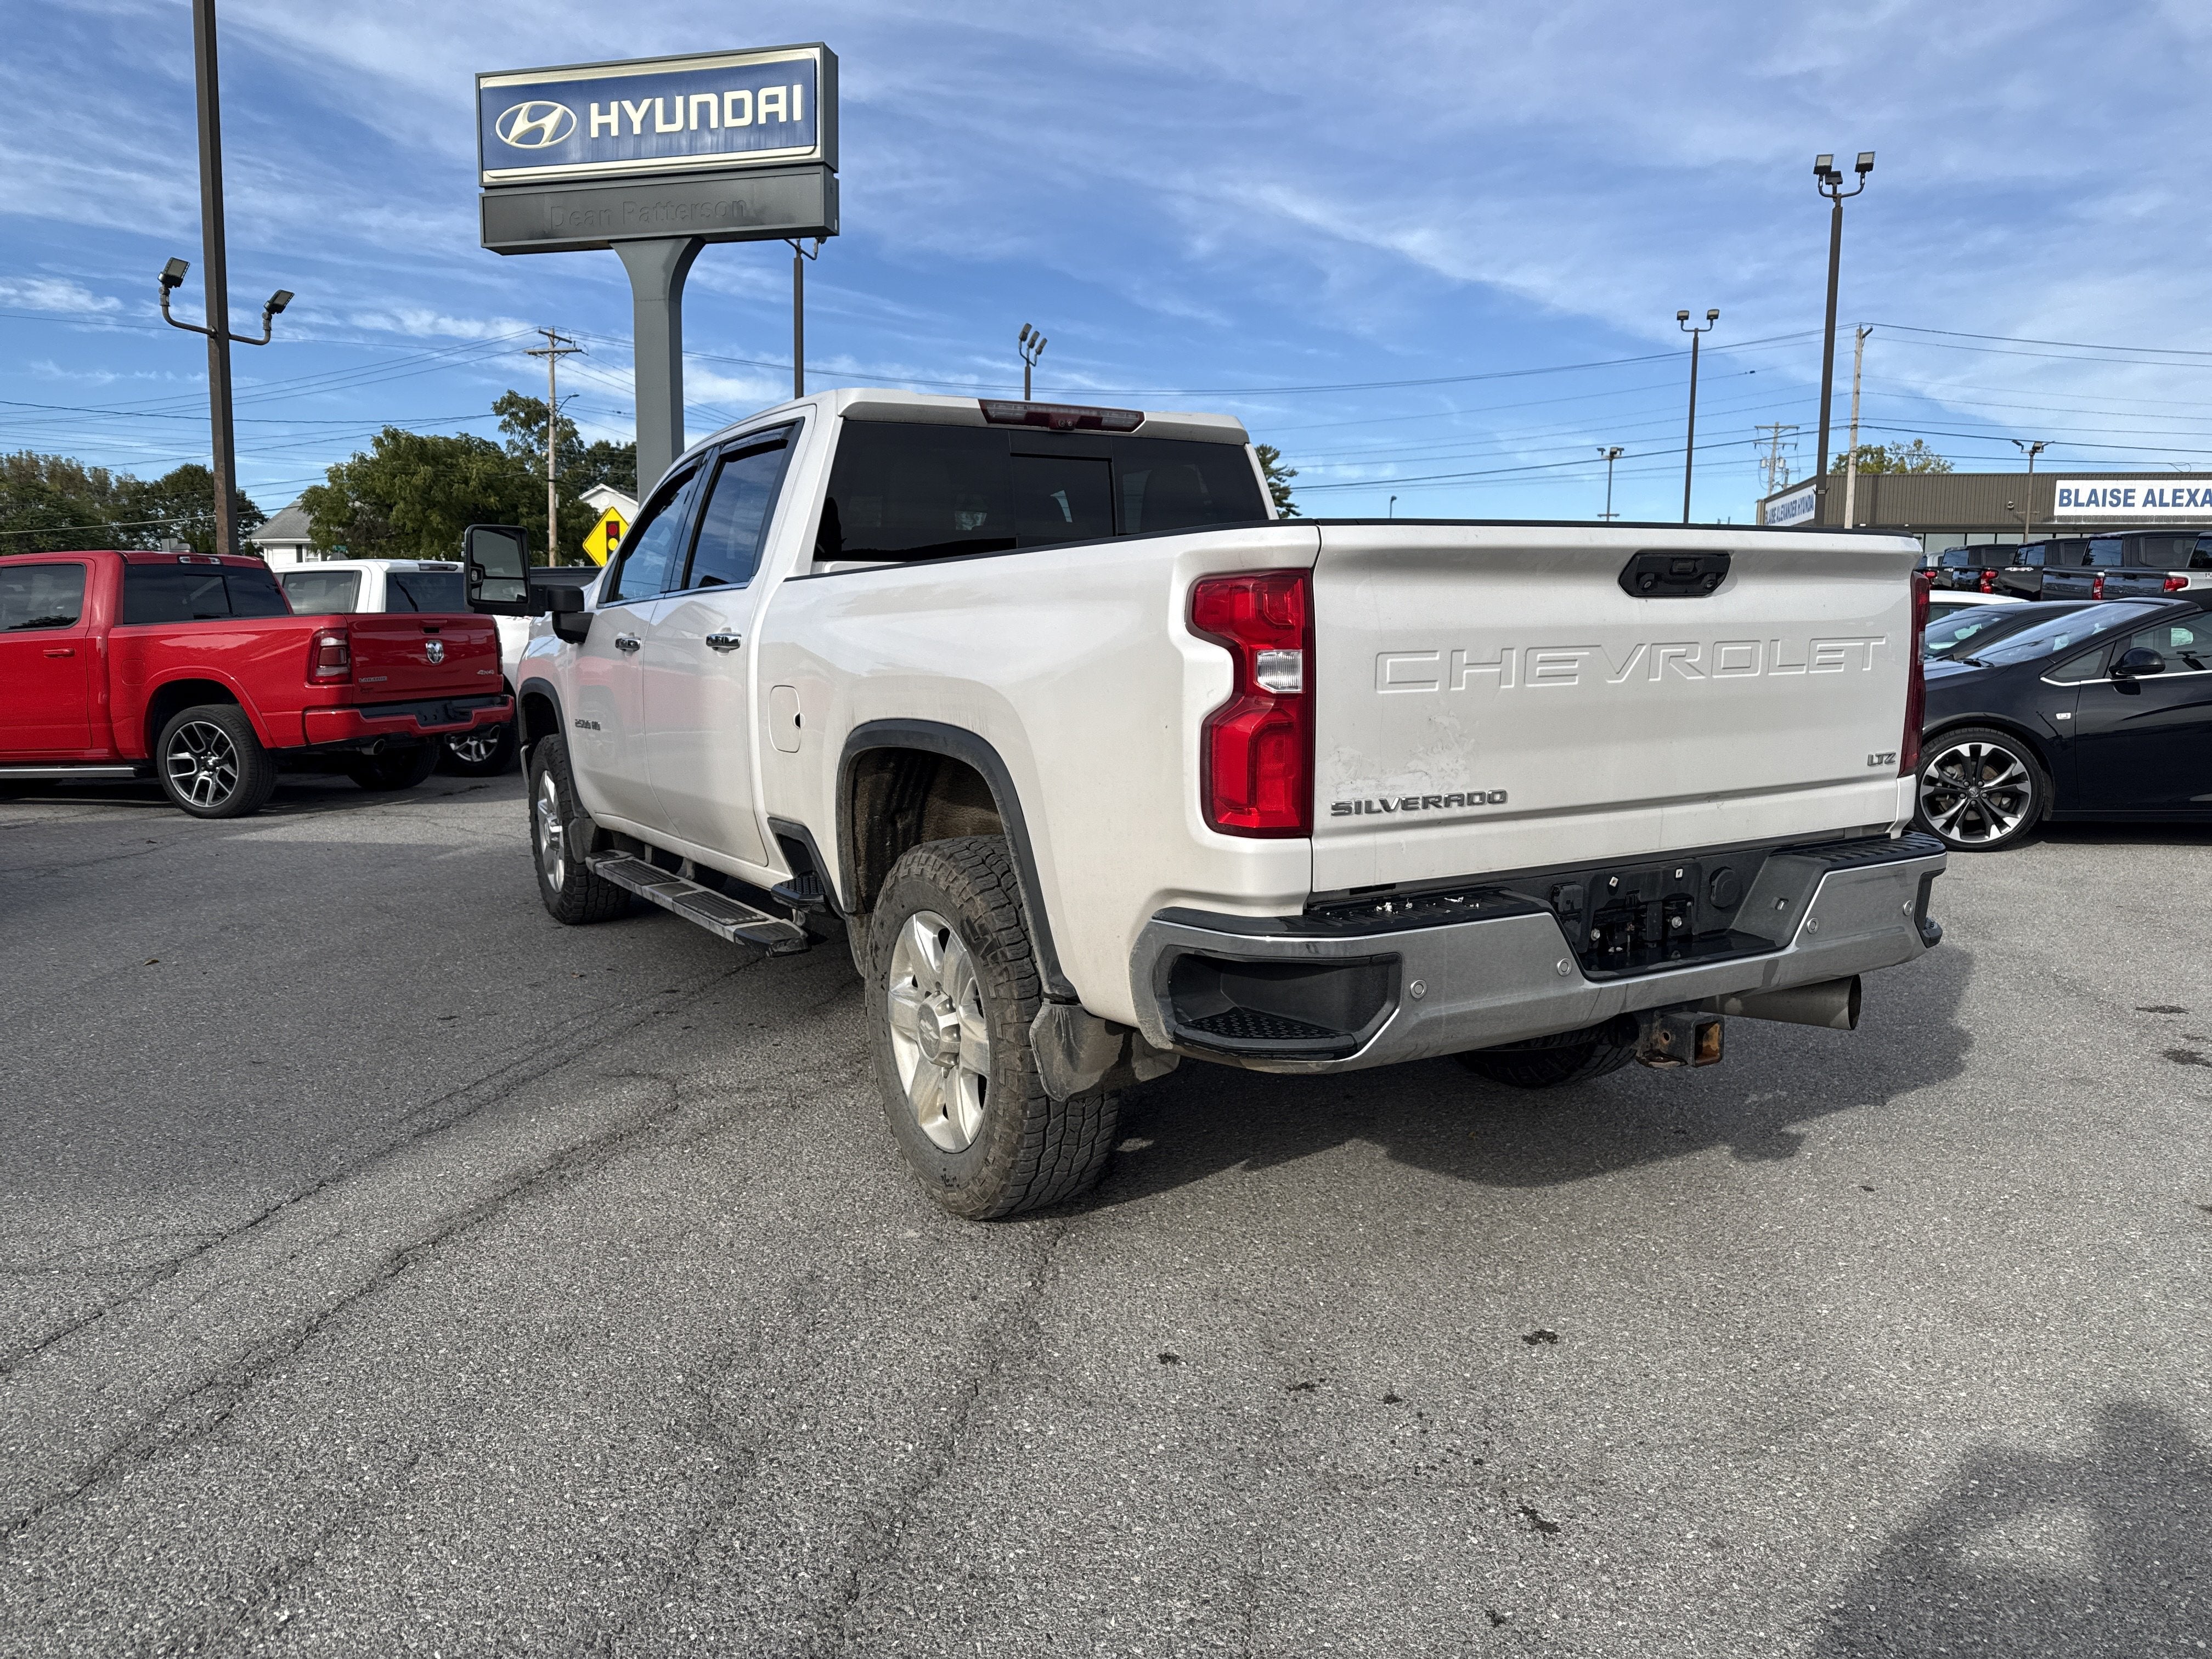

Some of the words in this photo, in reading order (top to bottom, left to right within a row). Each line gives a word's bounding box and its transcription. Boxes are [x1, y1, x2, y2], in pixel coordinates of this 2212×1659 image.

[590, 84, 803, 138] HYUNDAI
[550, 205, 611, 229] Dean
[623, 199, 747, 224] Patterson
[2058, 488, 2136, 507] BLAISE
[1375, 636, 1886, 693] CHEVROLET
[1867, 752, 1896, 766] LTZ
[1331, 789, 1508, 816] SILVERADO
